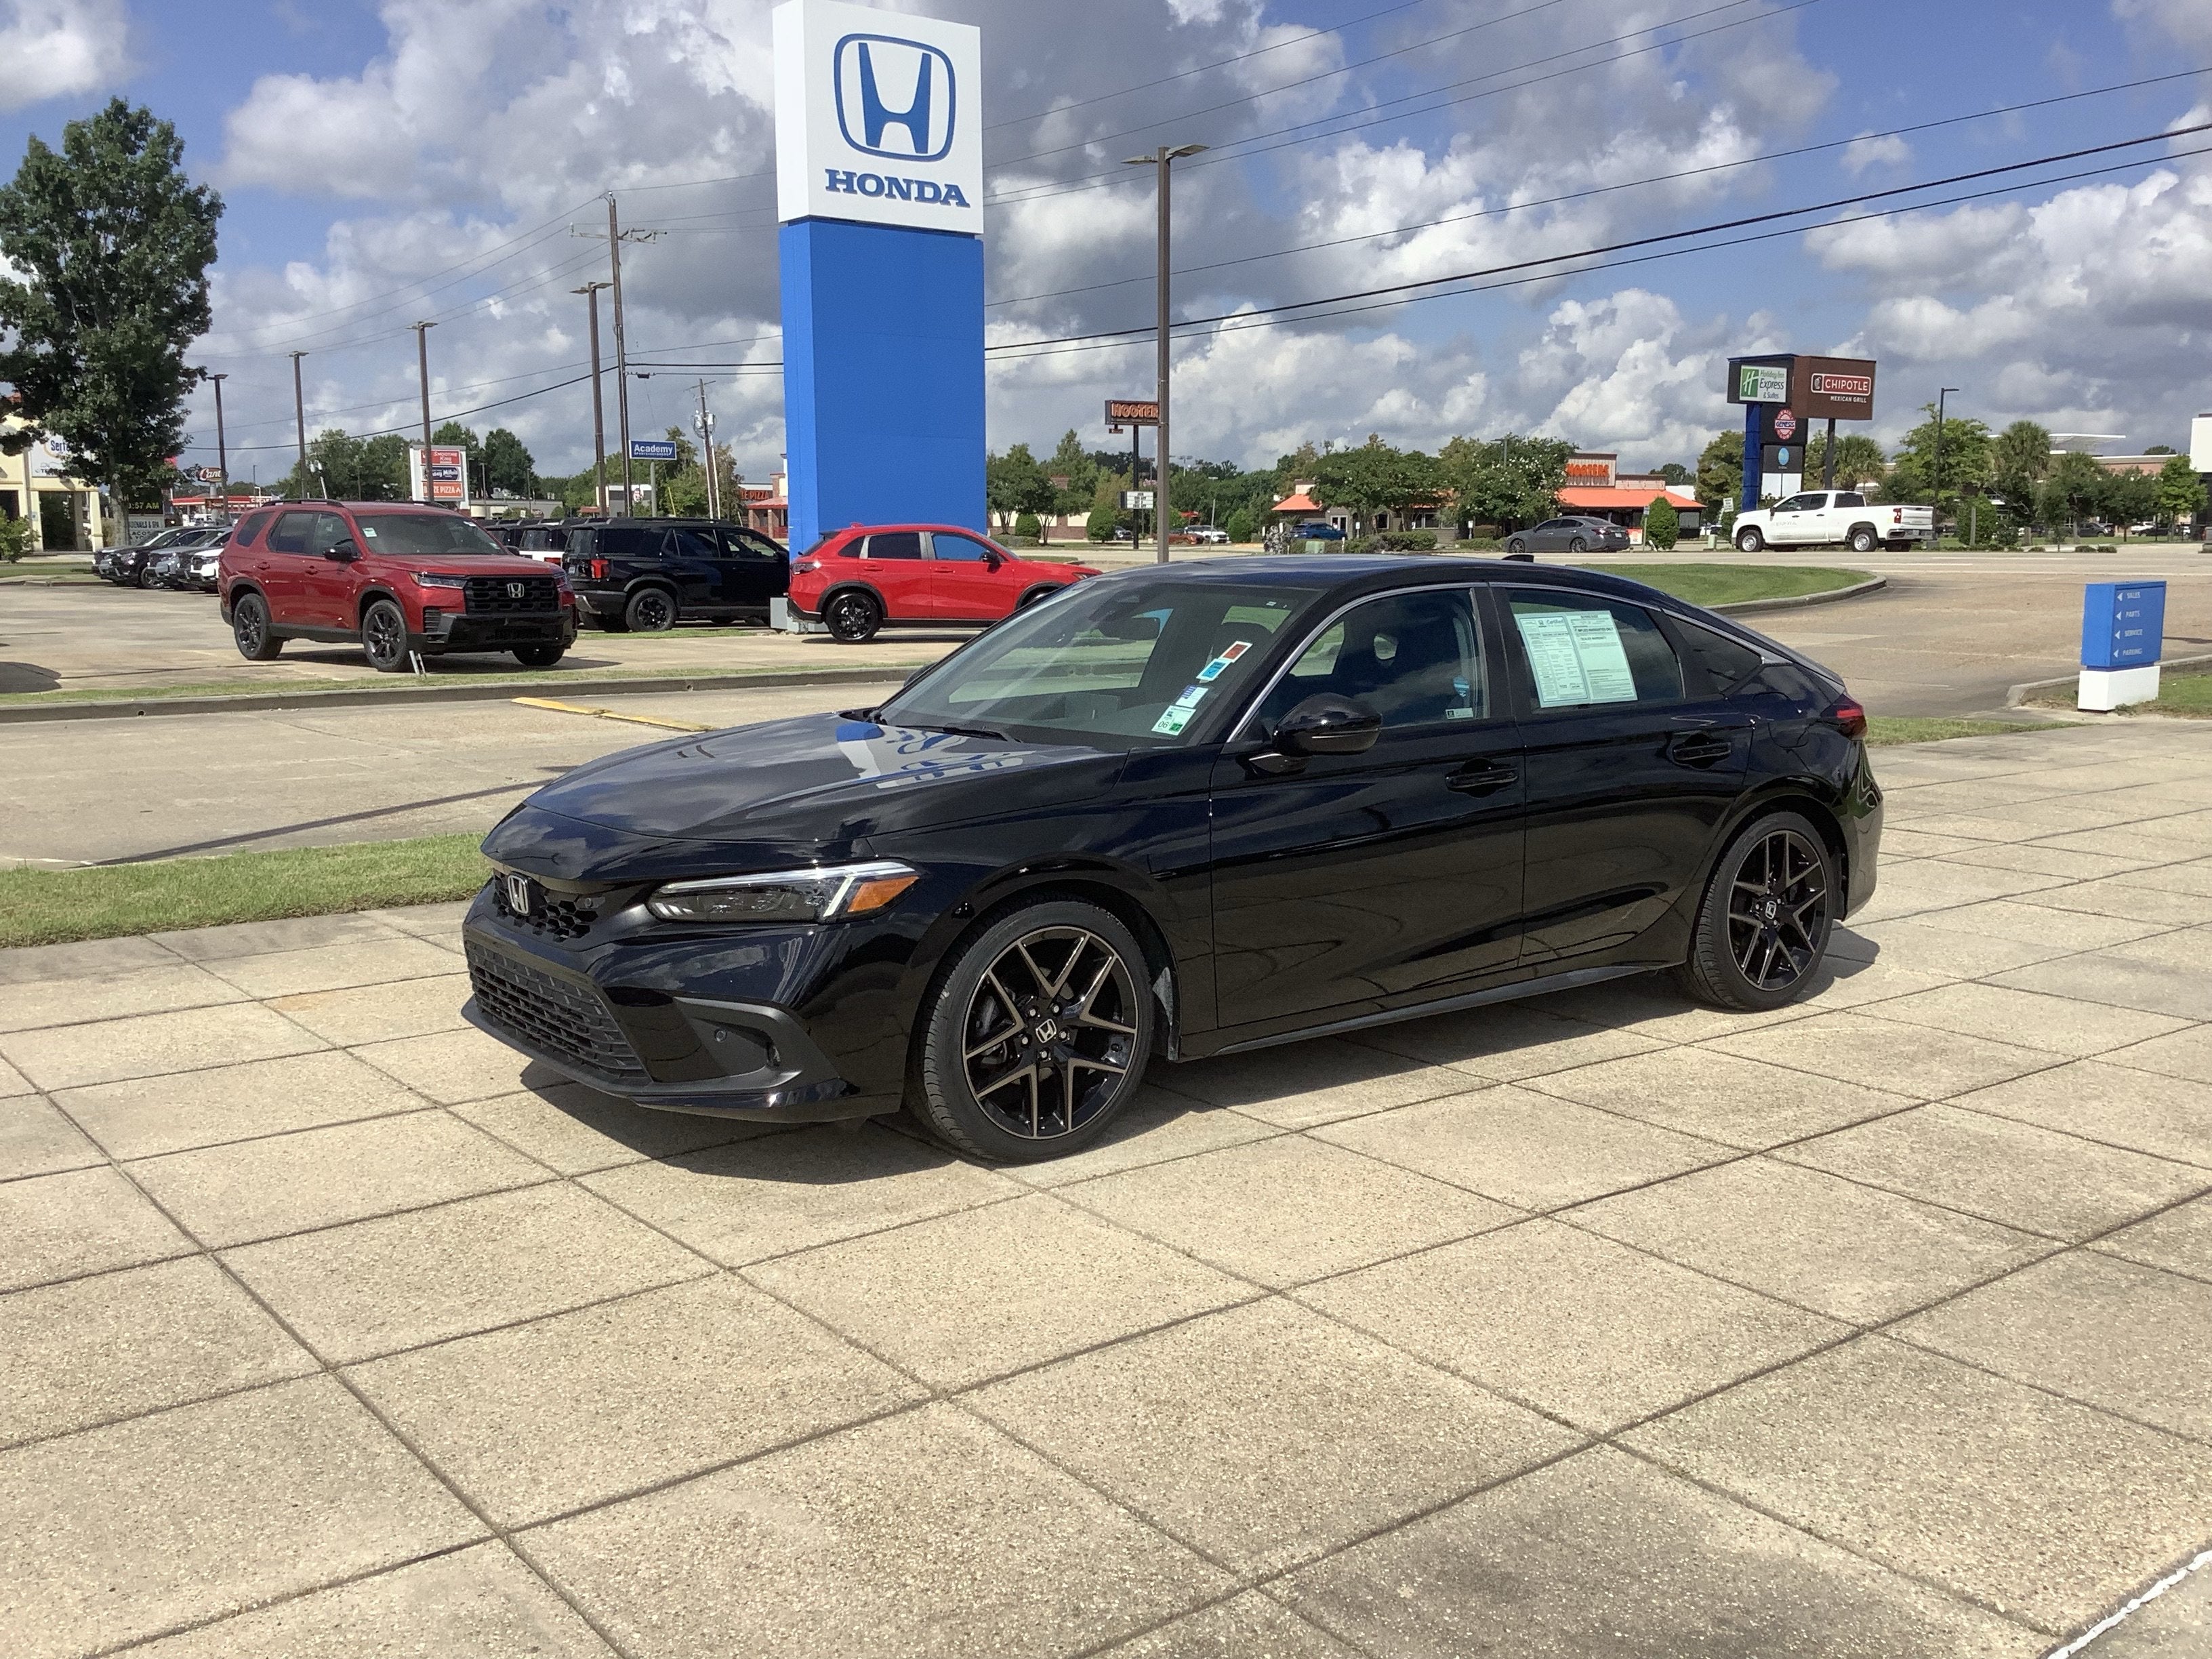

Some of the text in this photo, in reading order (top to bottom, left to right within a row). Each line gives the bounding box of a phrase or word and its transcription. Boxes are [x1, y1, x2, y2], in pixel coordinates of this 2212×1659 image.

[825, 169, 970, 208] HONDA
[1759, 378, 1784, 391] Express
[1825, 379, 1868, 391] CHIPOTLE
[1111, 403, 1159, 417] HOOTER
[634, 444, 673, 455] Academy
